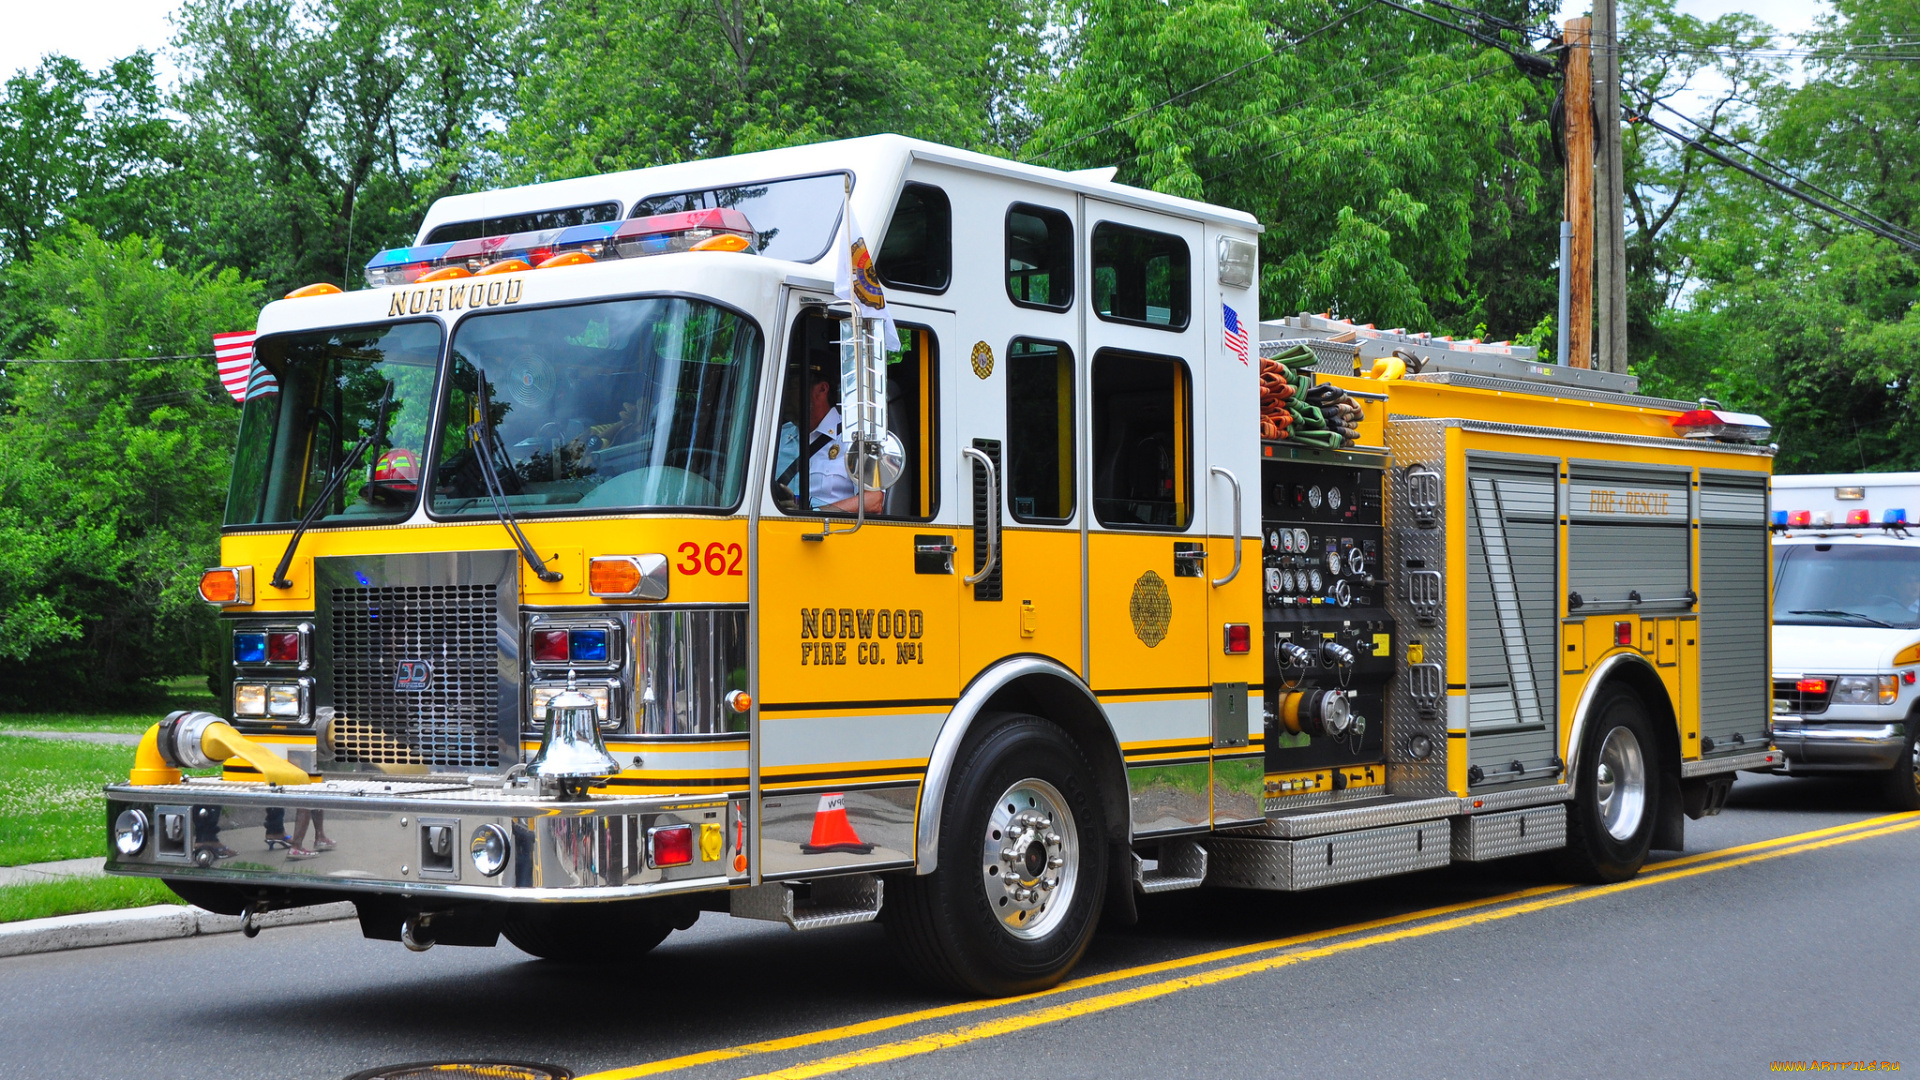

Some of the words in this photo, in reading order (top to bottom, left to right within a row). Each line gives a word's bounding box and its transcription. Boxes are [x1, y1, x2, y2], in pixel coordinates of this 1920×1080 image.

[388, 278, 525, 316] NORWOOD
[1589, 489, 1616, 513] FIRE
[1624, 491, 1669, 515] RESCUE
[677, 541, 743, 576] 362
[801, 608, 924, 639] NORWOOD
[801, 642, 847, 666] FIRE
[858, 642, 885, 665] CO.
